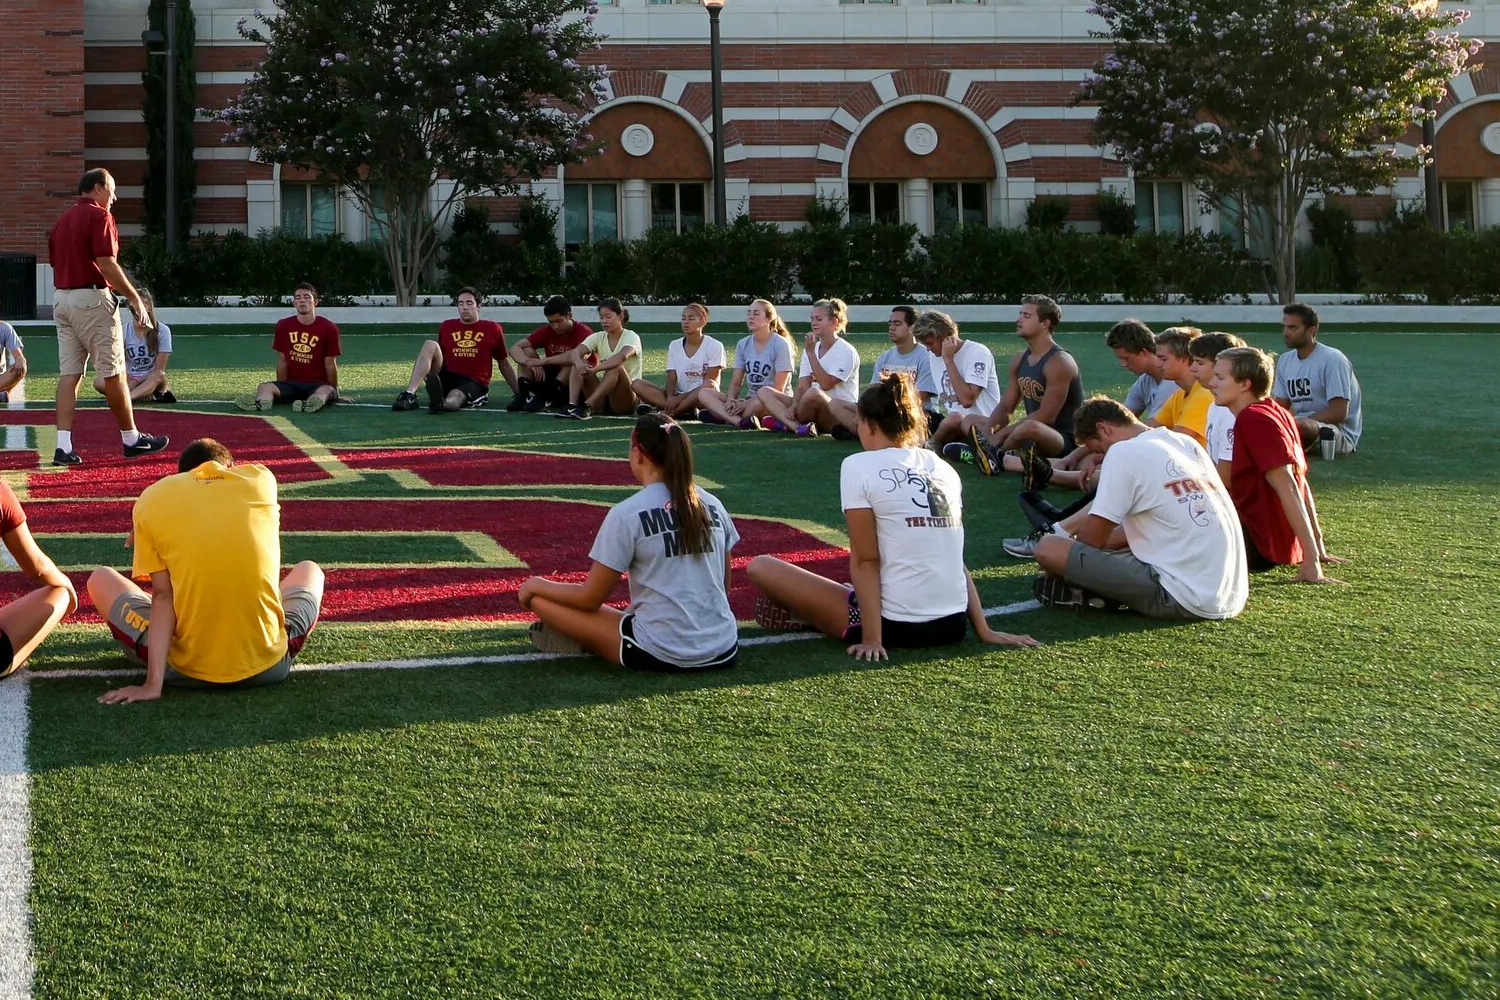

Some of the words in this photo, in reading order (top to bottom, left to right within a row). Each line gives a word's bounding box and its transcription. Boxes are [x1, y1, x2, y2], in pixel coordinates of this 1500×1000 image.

[289, 331, 319, 348] USC
[451, 330, 485, 342] USC
[1287, 377, 1311, 398] USC
[638, 504, 721, 538] MUE
[905, 517, 926, 528] THE
[926, 517, 948, 528] TIME
[125, 611, 149, 632] USC
